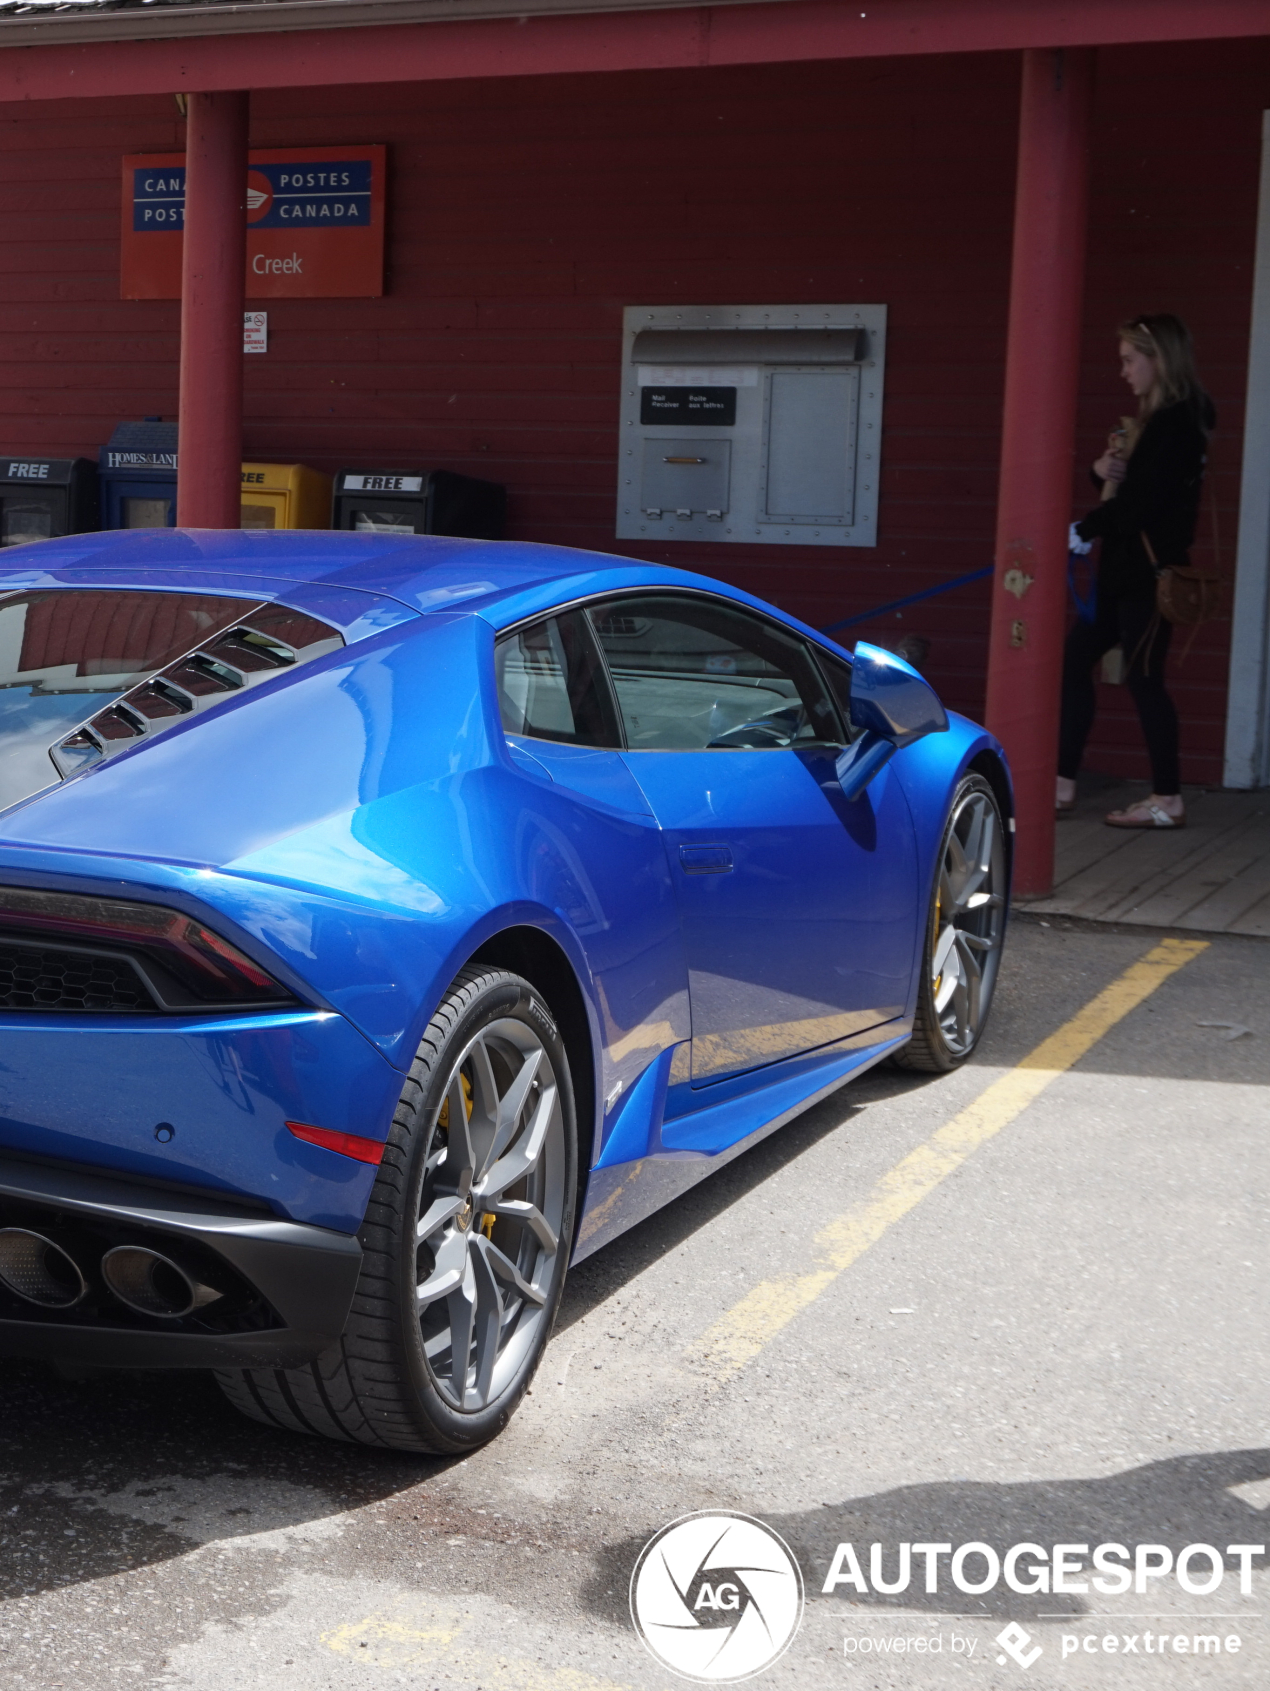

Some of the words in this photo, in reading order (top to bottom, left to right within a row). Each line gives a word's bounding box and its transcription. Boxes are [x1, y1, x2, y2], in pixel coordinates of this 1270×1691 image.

[280, 172, 350, 187] POSTES
[279, 203, 359, 218] CANADA
[252, 252, 303, 274] Creek
[8, 463, 50, 478] FREE
[362, 476, 404, 490] FREE
